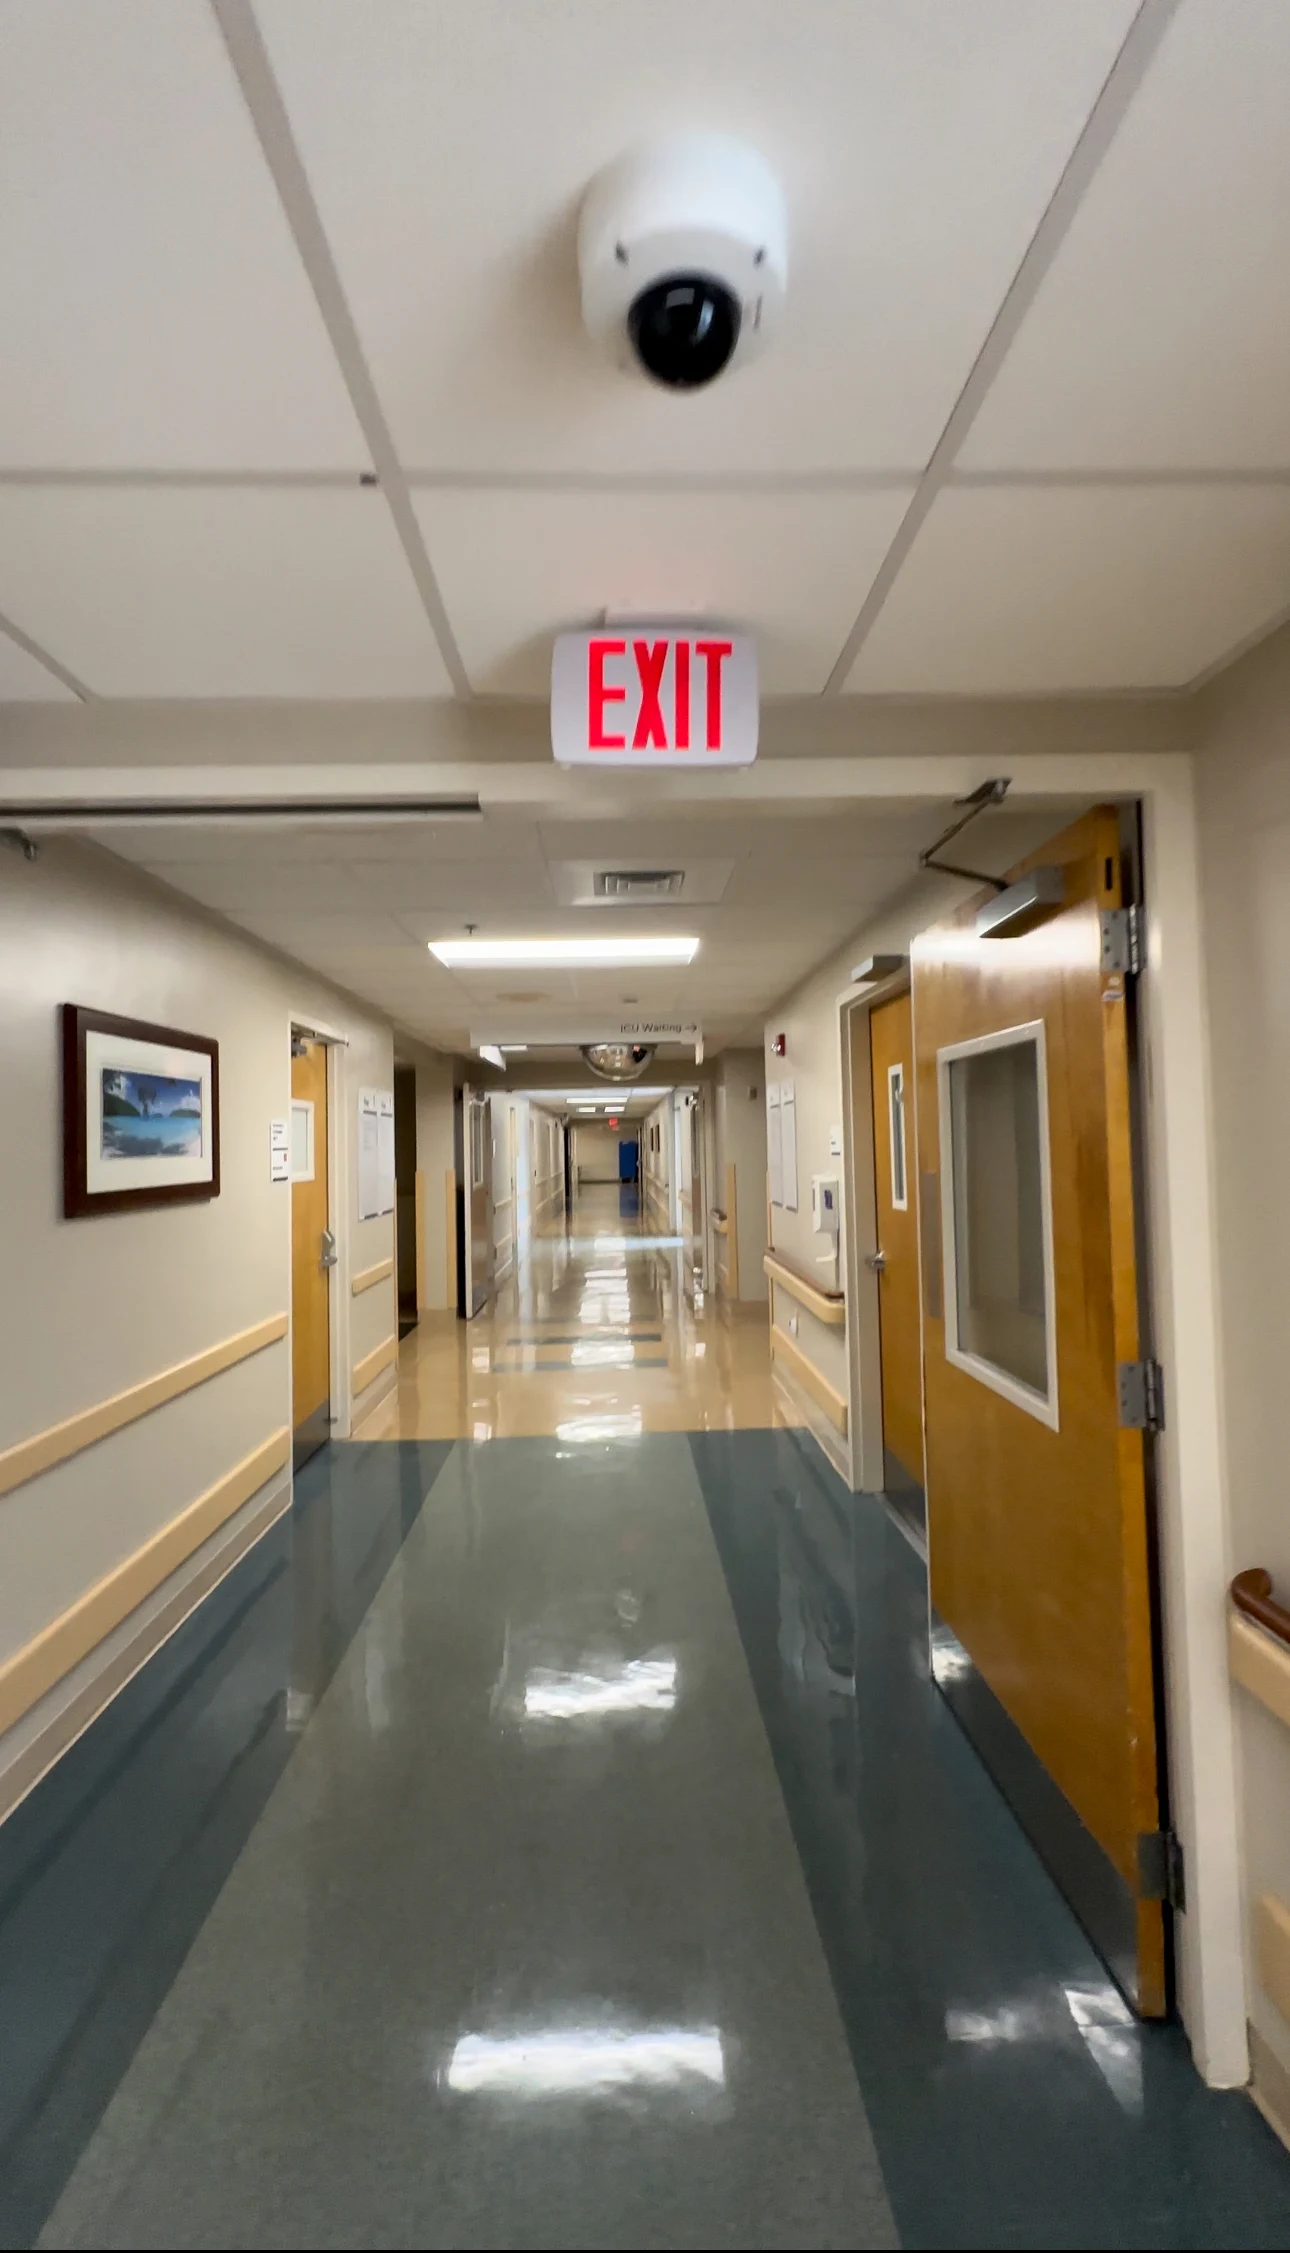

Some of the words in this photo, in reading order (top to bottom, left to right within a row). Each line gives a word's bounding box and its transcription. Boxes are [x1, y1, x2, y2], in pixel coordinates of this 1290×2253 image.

[588, 638, 733, 751] EXIT
[620, 1023, 639, 1033] ICU
[642, 1023, 682, 1034] Waiting
